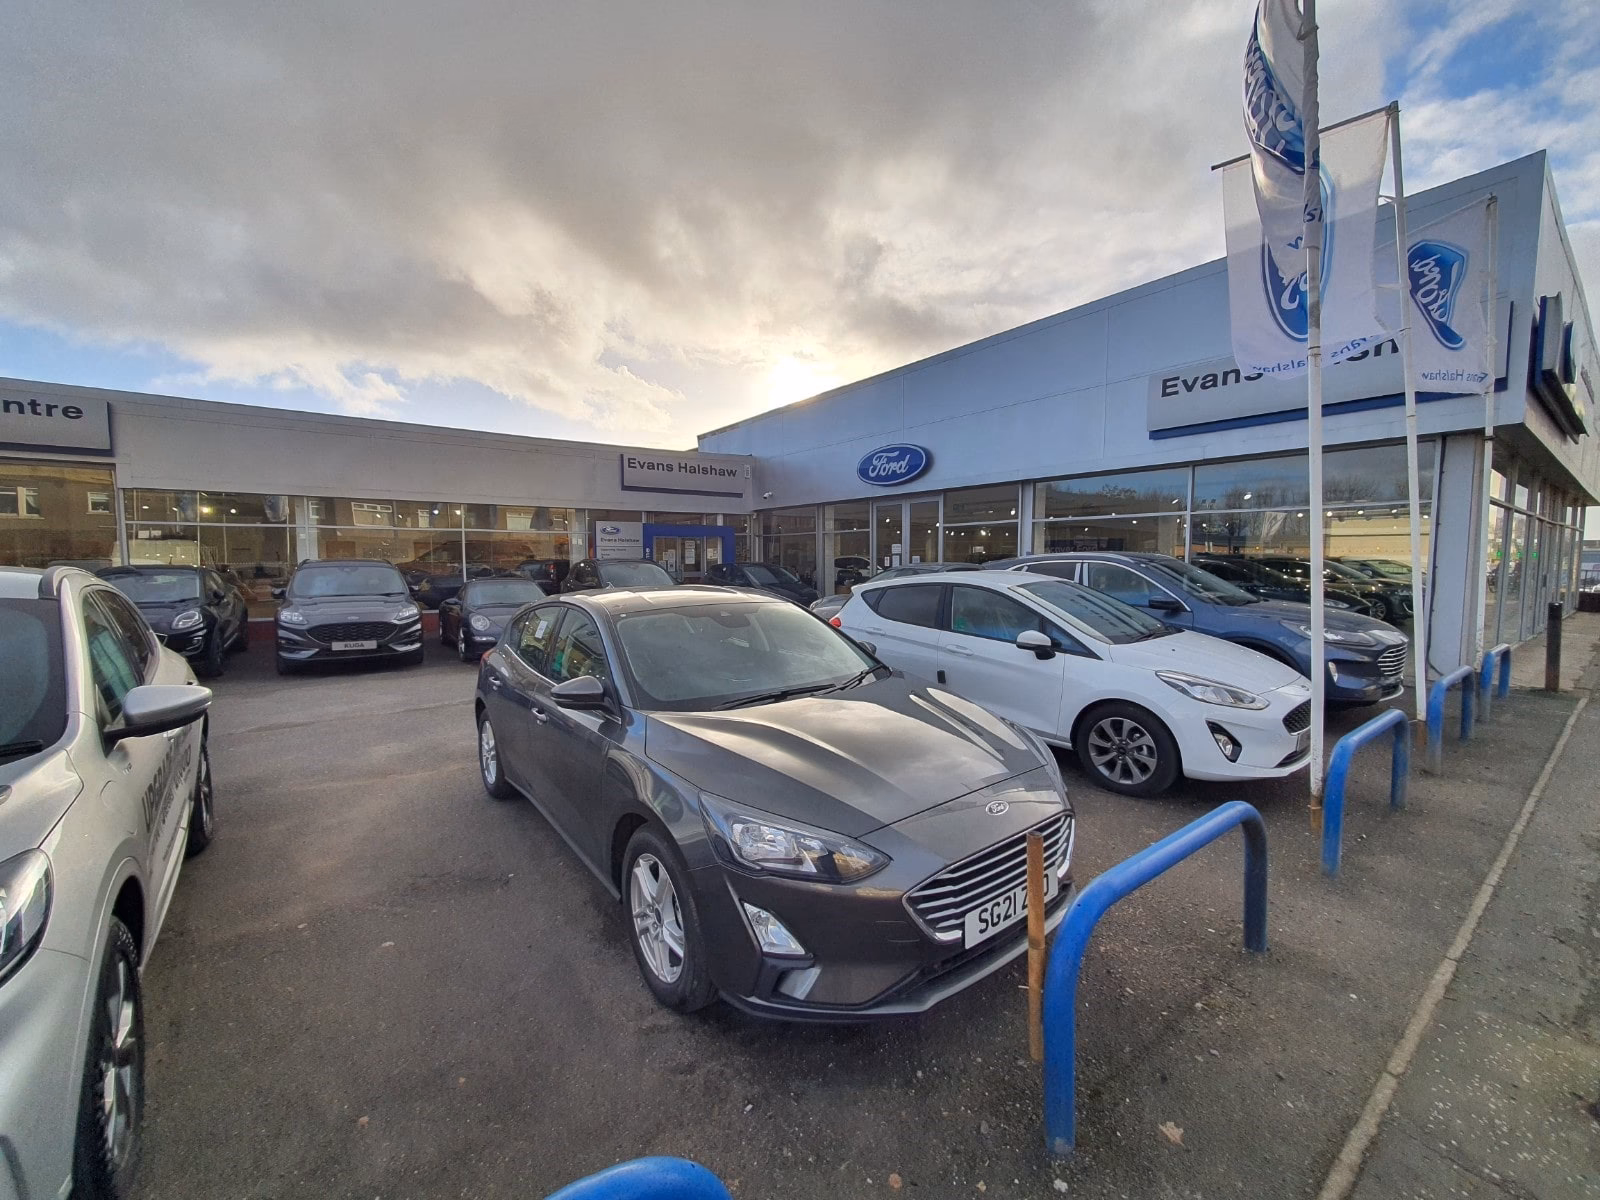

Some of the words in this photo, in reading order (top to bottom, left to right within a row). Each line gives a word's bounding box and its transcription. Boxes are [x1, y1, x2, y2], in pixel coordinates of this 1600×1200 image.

[627, 457, 674, 472] Evans
[678, 462, 738, 477] Halshaw
[869, 450, 910, 477] Ford
[978, 892, 1017, 934] SG21
